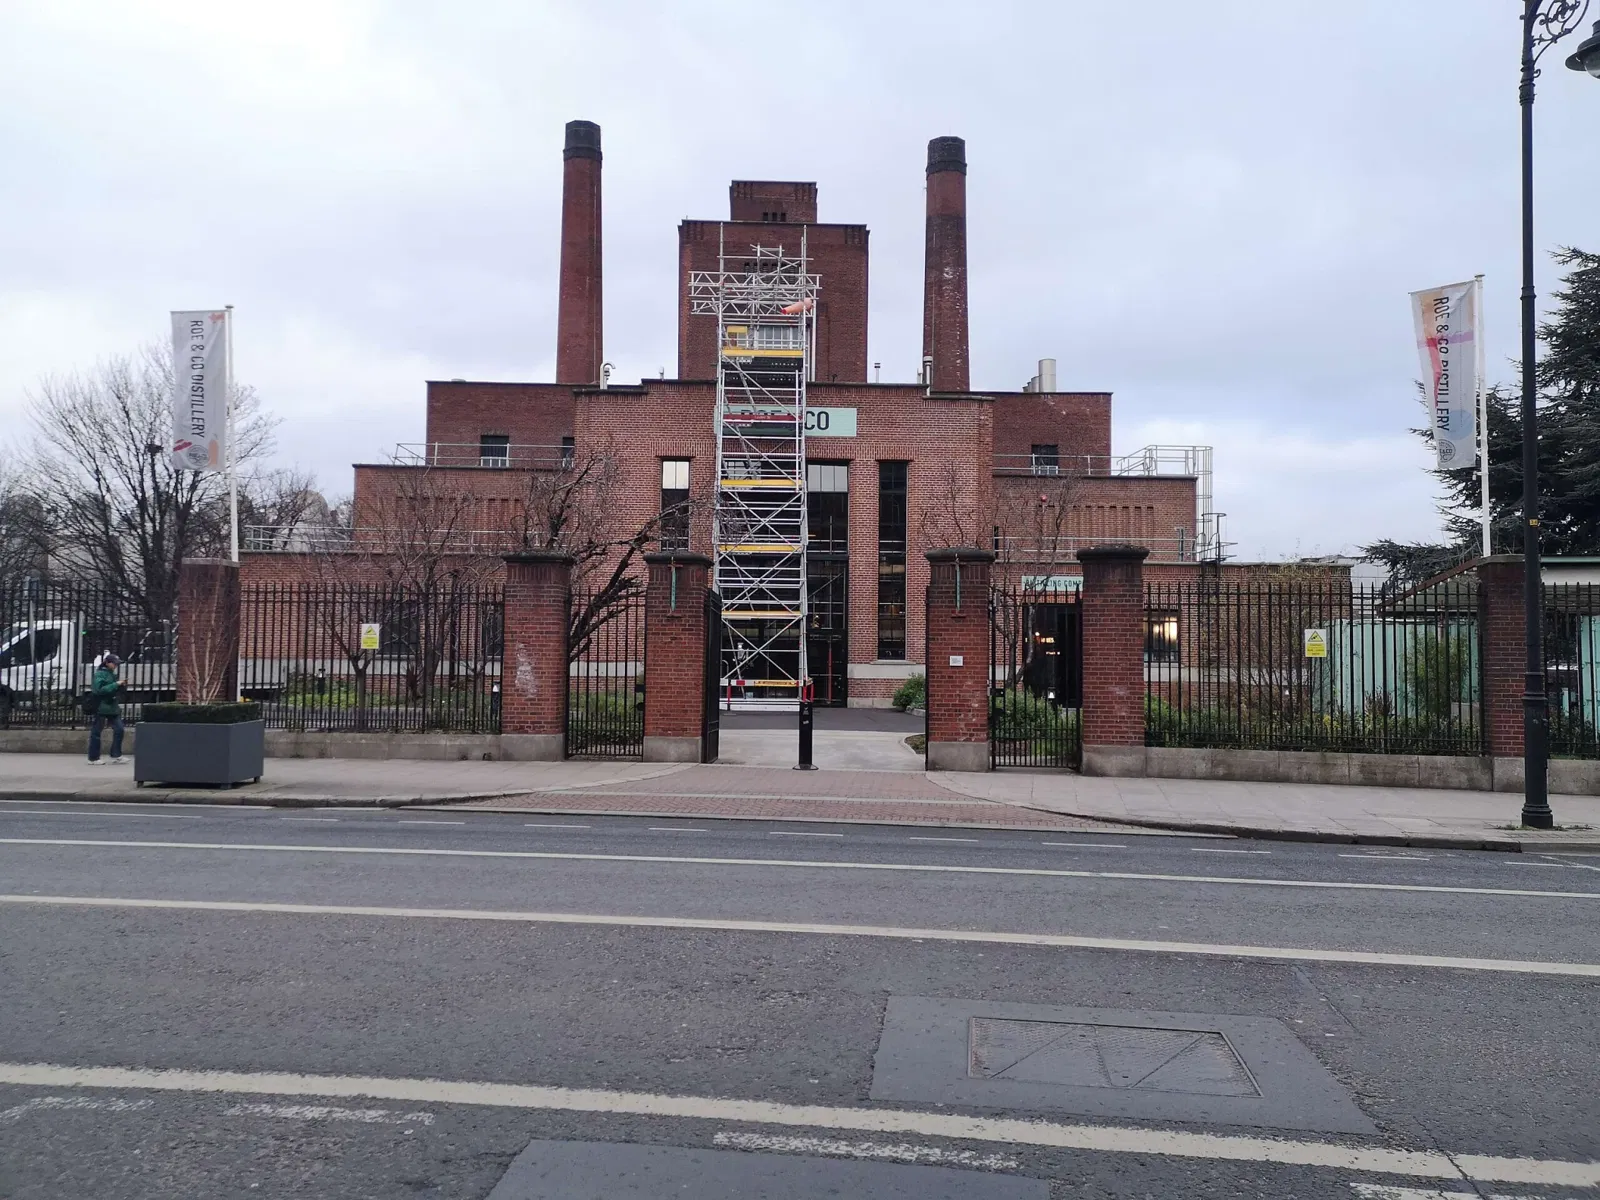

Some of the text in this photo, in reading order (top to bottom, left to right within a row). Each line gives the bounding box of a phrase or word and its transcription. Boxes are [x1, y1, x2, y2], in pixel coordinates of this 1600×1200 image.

[1433, 296, 1450, 322] ROE
[190, 320, 204, 341] ROE
[1435, 324, 1449, 334] &
[191, 344, 205, 352] &
[1437, 338, 1449, 355] CO
[191, 356, 205, 371] CO
[190, 374, 205, 438] DISTILLERY
[804, 410, 830, 431] CO
